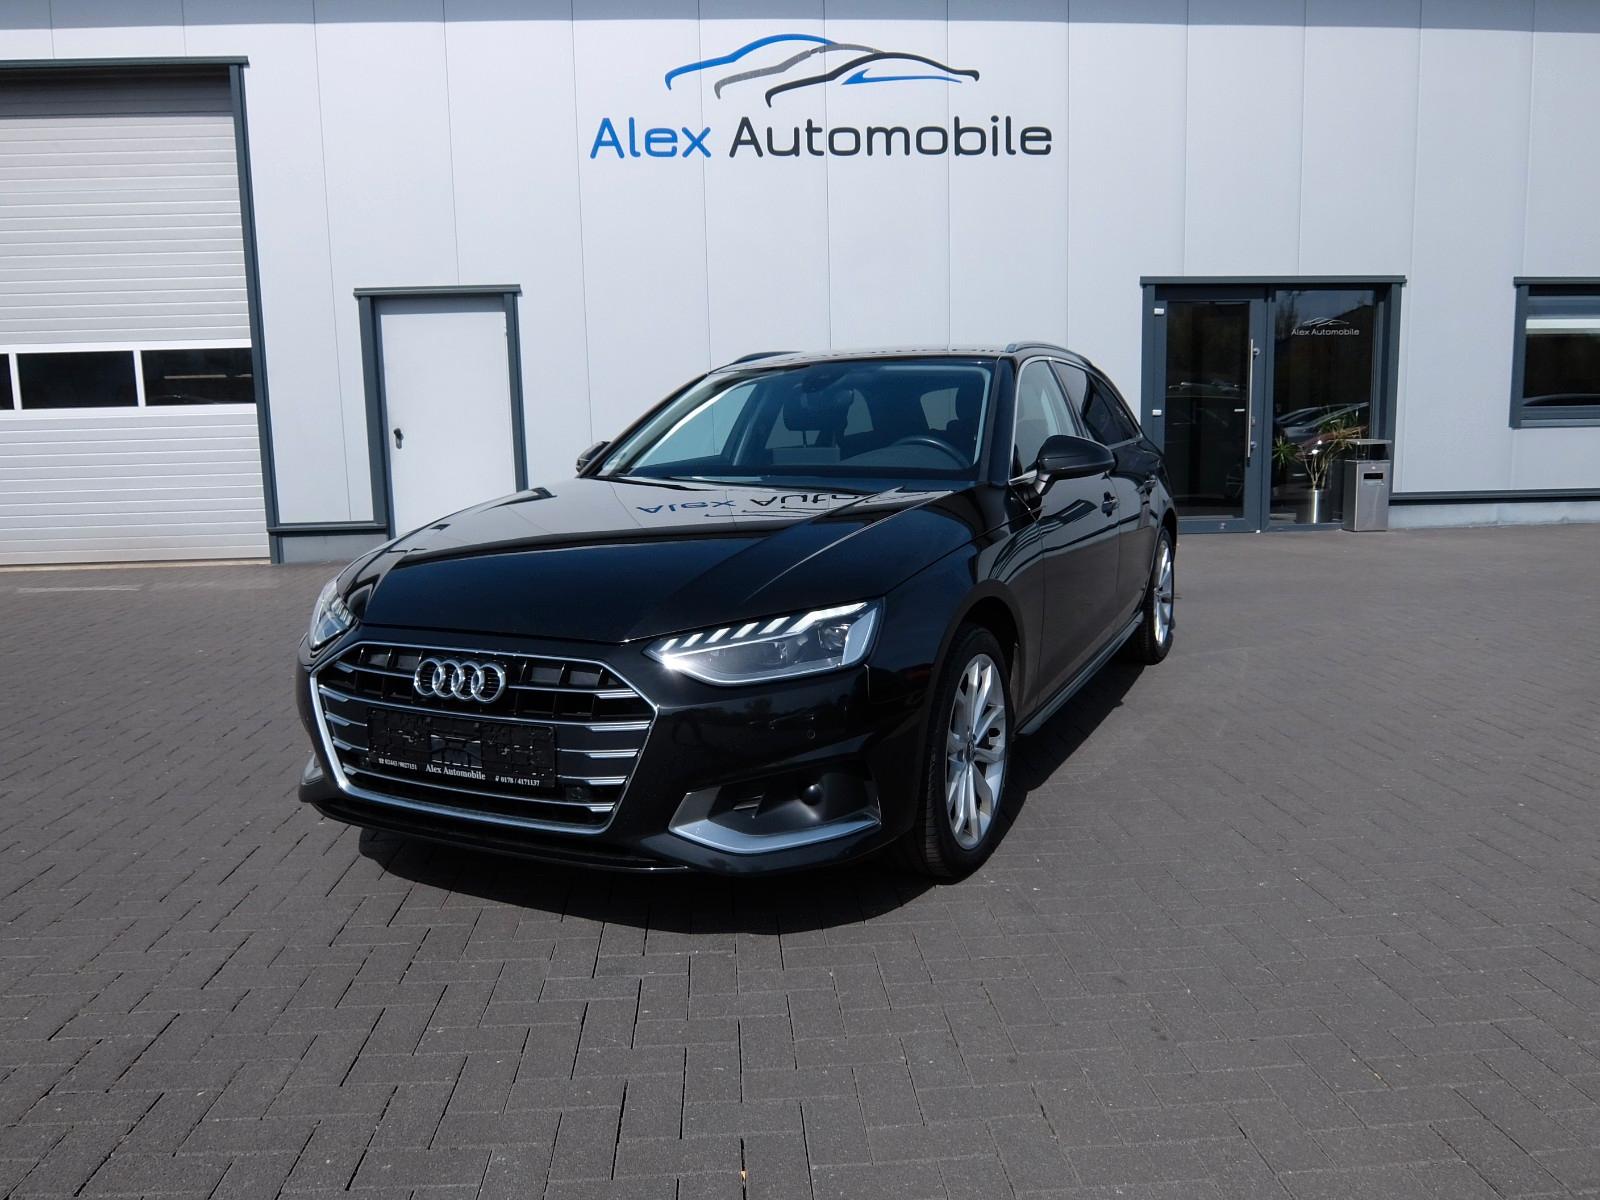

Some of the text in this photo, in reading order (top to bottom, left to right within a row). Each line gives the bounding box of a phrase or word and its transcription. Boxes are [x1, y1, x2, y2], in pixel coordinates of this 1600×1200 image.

[590, 115, 1052, 158] Alex Automobile
[425, 764, 486, 780] Alex Automobile
